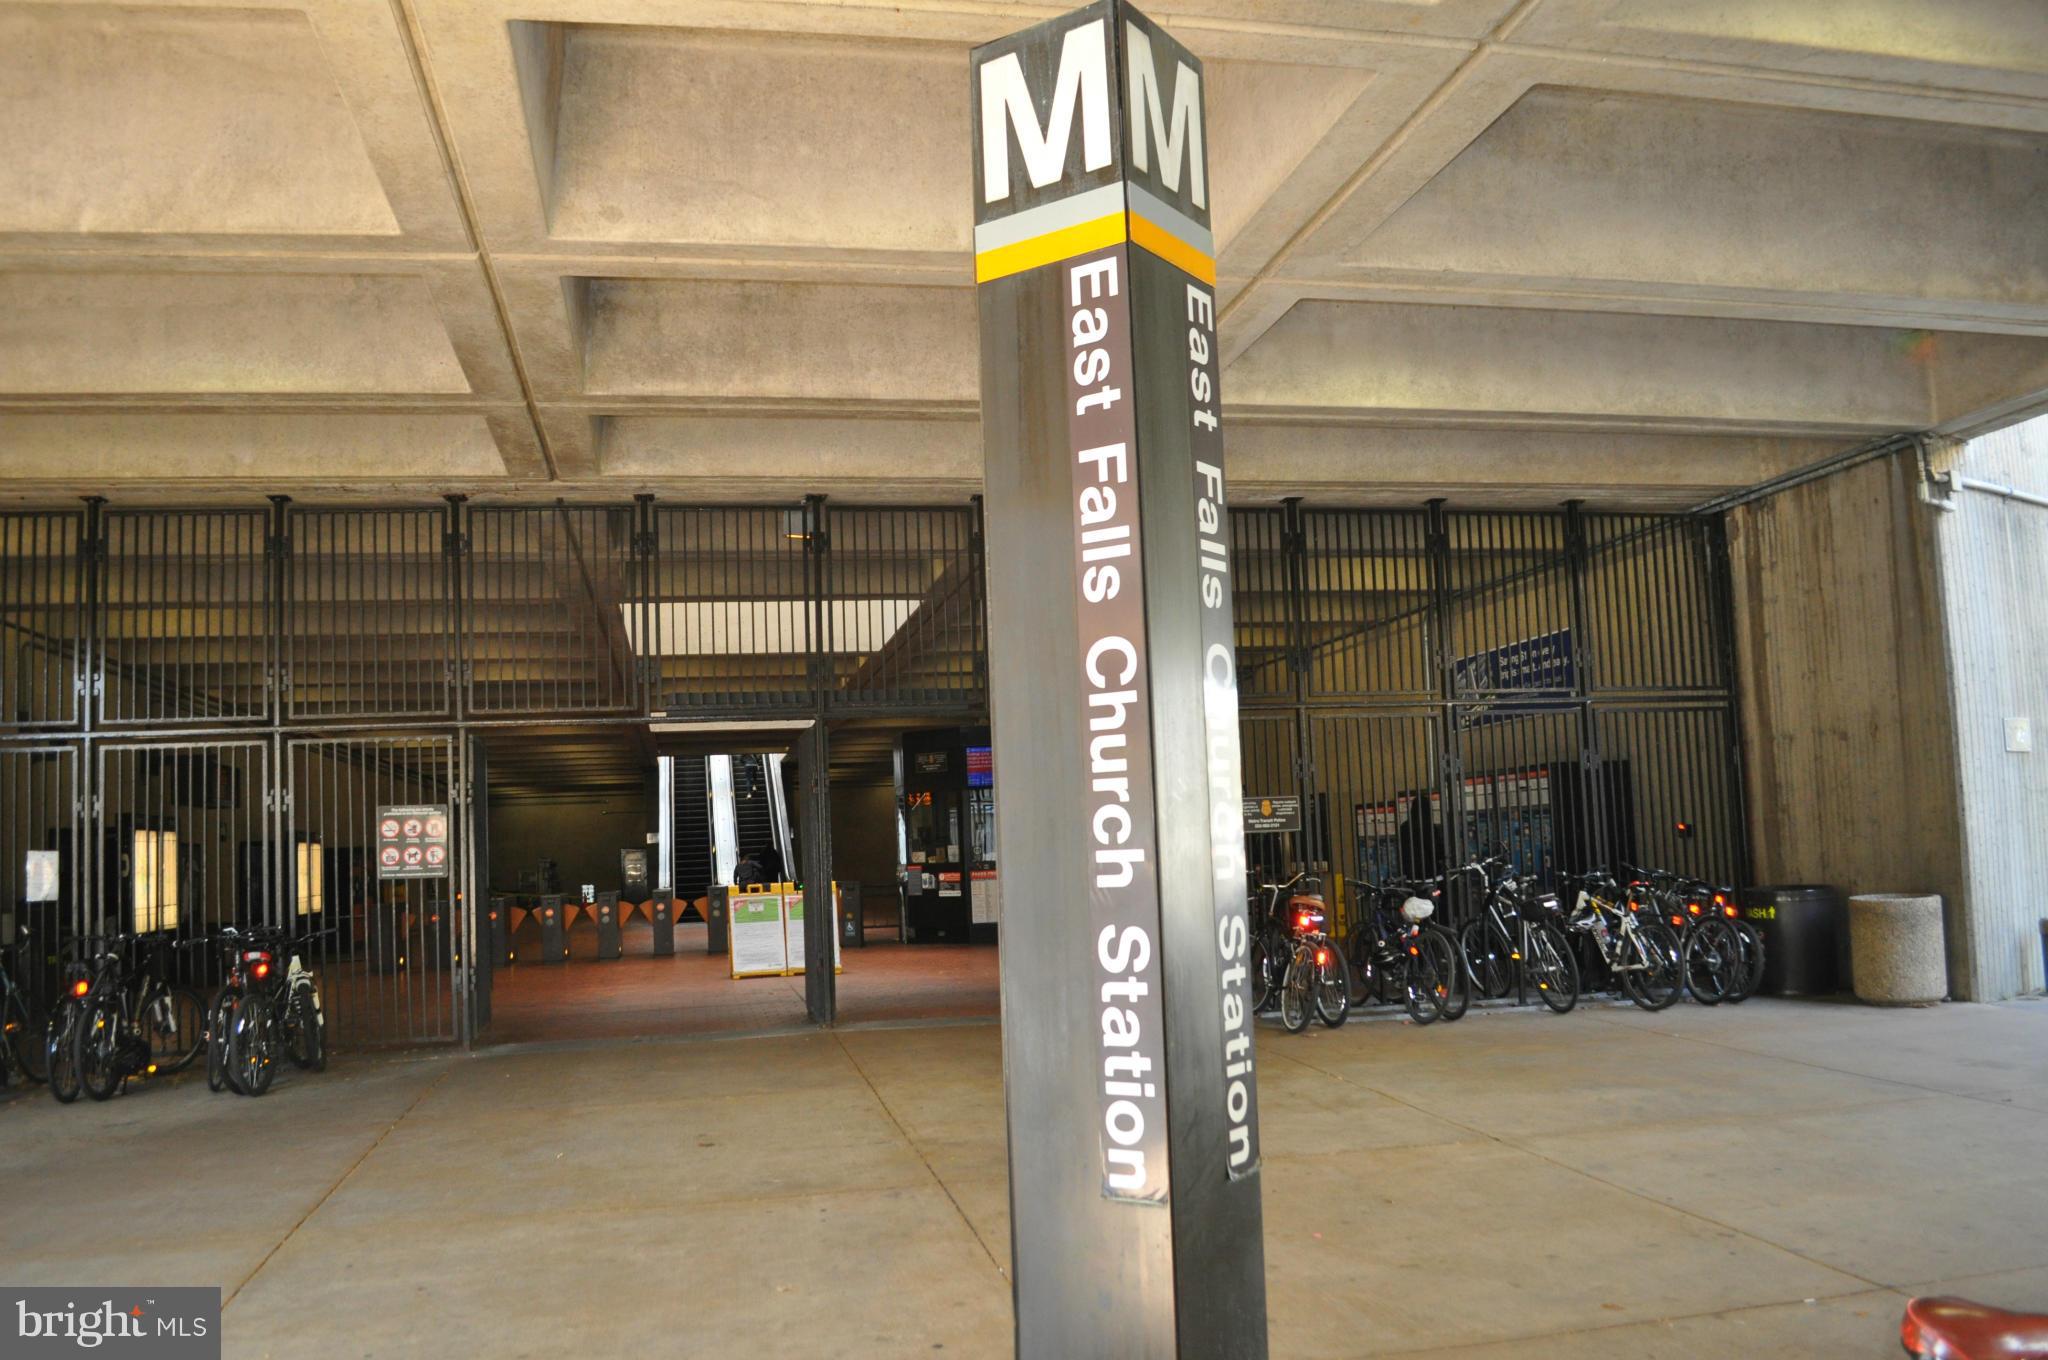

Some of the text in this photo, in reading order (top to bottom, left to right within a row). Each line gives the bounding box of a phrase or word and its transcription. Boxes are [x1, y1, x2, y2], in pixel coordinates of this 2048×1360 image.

[980, 18, 1112, 205] M
[1126, 20, 1206, 210] M
[1186, 283, 1218, 432] East
[1196, 460, 1227, 609] Falls
[1070, 256, 1155, 1190] East Falls Church Station
[1218, 914, 1253, 1167] Station
